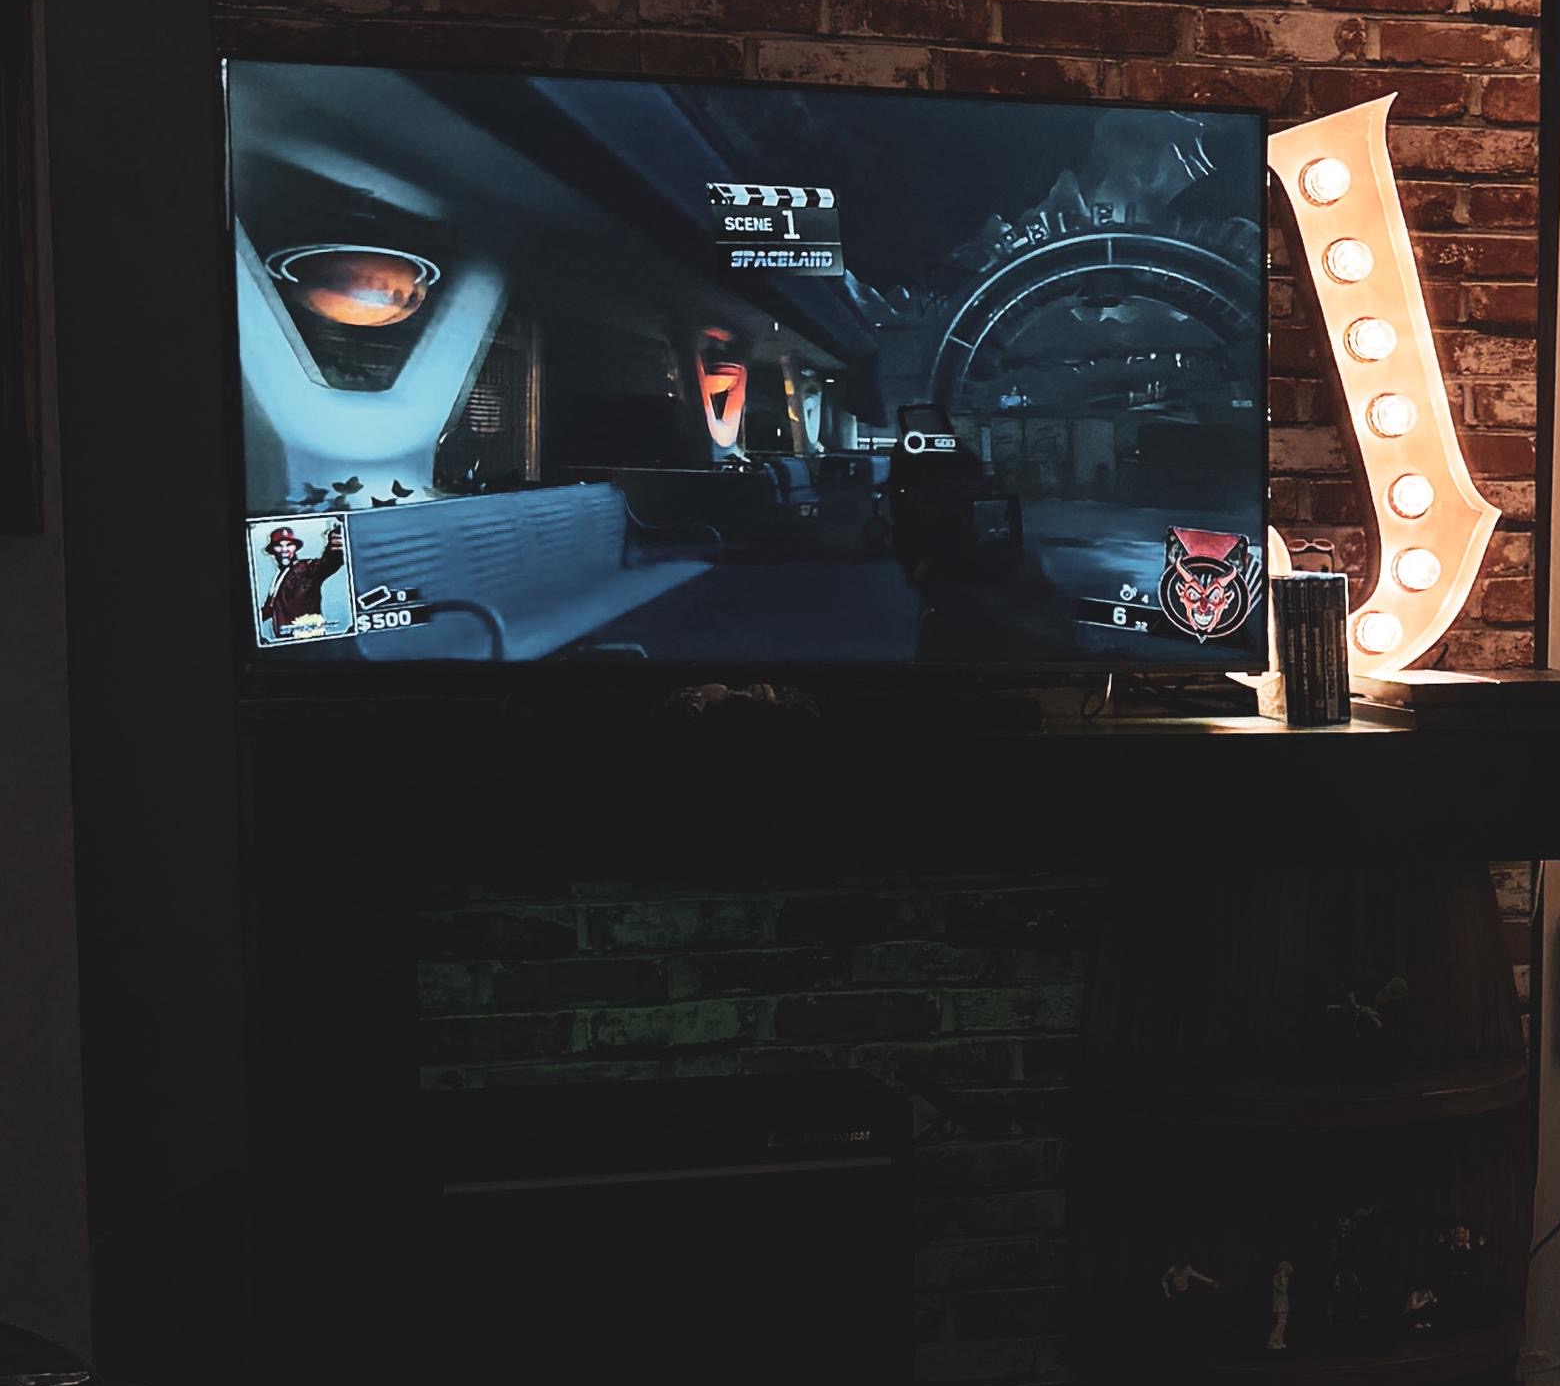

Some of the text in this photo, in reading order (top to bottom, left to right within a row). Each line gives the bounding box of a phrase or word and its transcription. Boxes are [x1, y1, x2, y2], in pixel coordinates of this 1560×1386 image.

[724, 209, 801, 240] SCENE 1
[730, 250, 833, 269] SPACELAND
[357, 610, 412, 632] $500
[1112, 607, 1127, 626] 6
